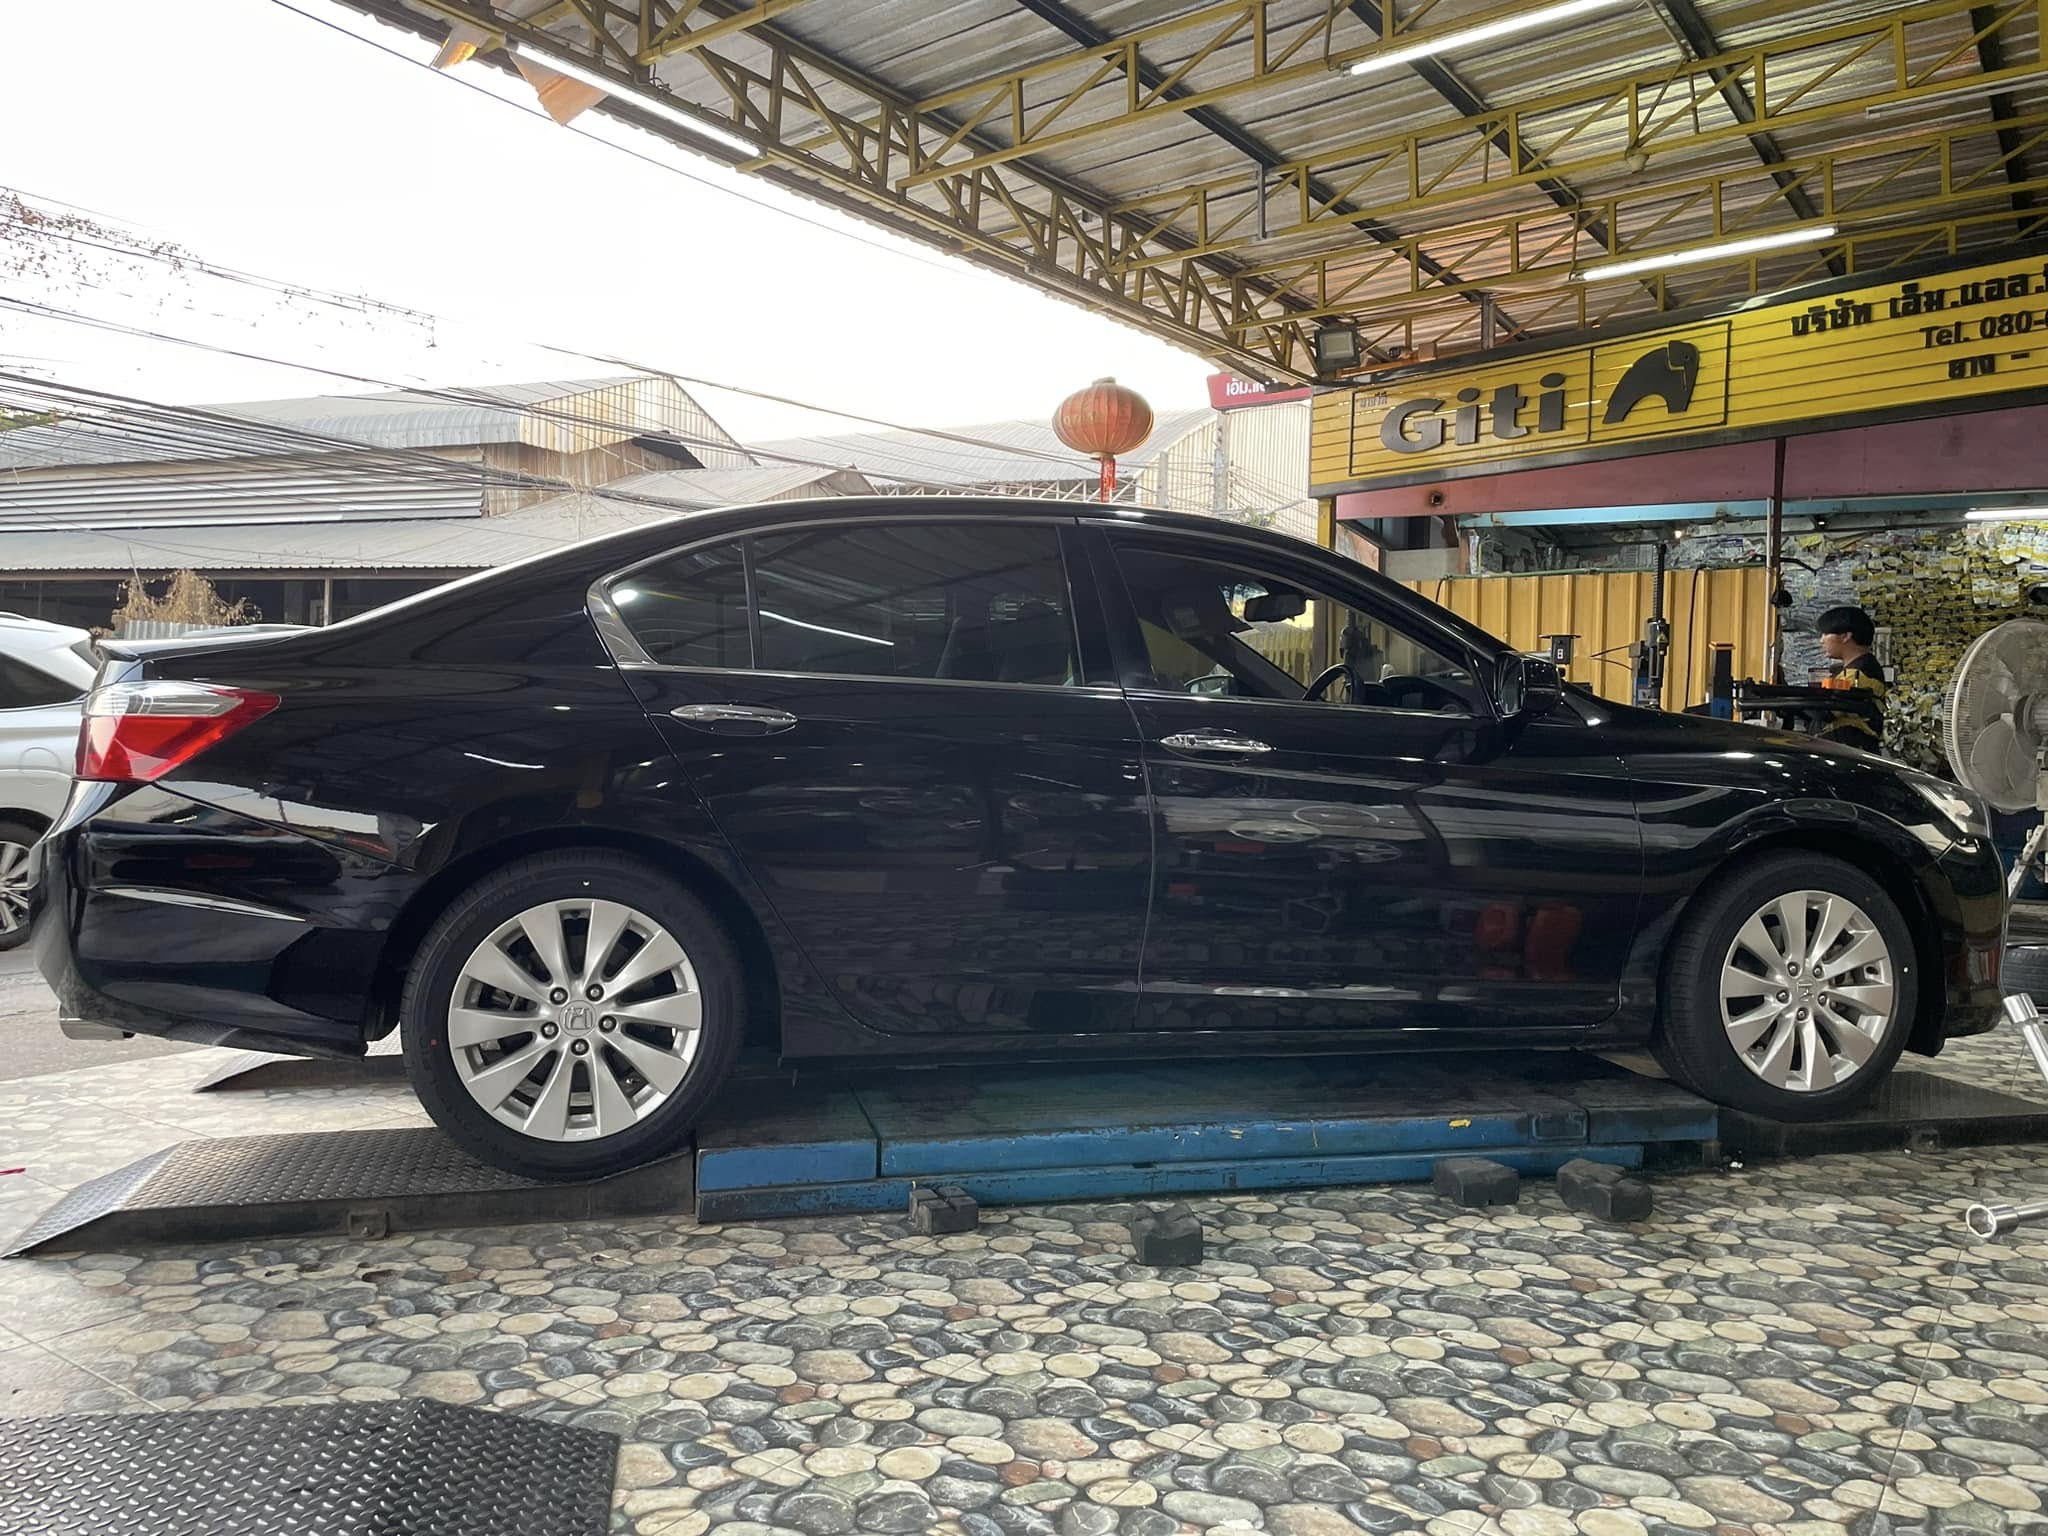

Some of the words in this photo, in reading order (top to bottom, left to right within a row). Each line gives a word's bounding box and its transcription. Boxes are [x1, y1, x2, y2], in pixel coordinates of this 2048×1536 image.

[1791, 298, 1872, 337] บริษัท
[1889, 264, 2048, 319] เอ็ม.แอล.
[1919, 321, 1971, 348] Tel.
[1979, 311, 2048, 338] 080-
[1380, 372, 1567, 454] Giti
